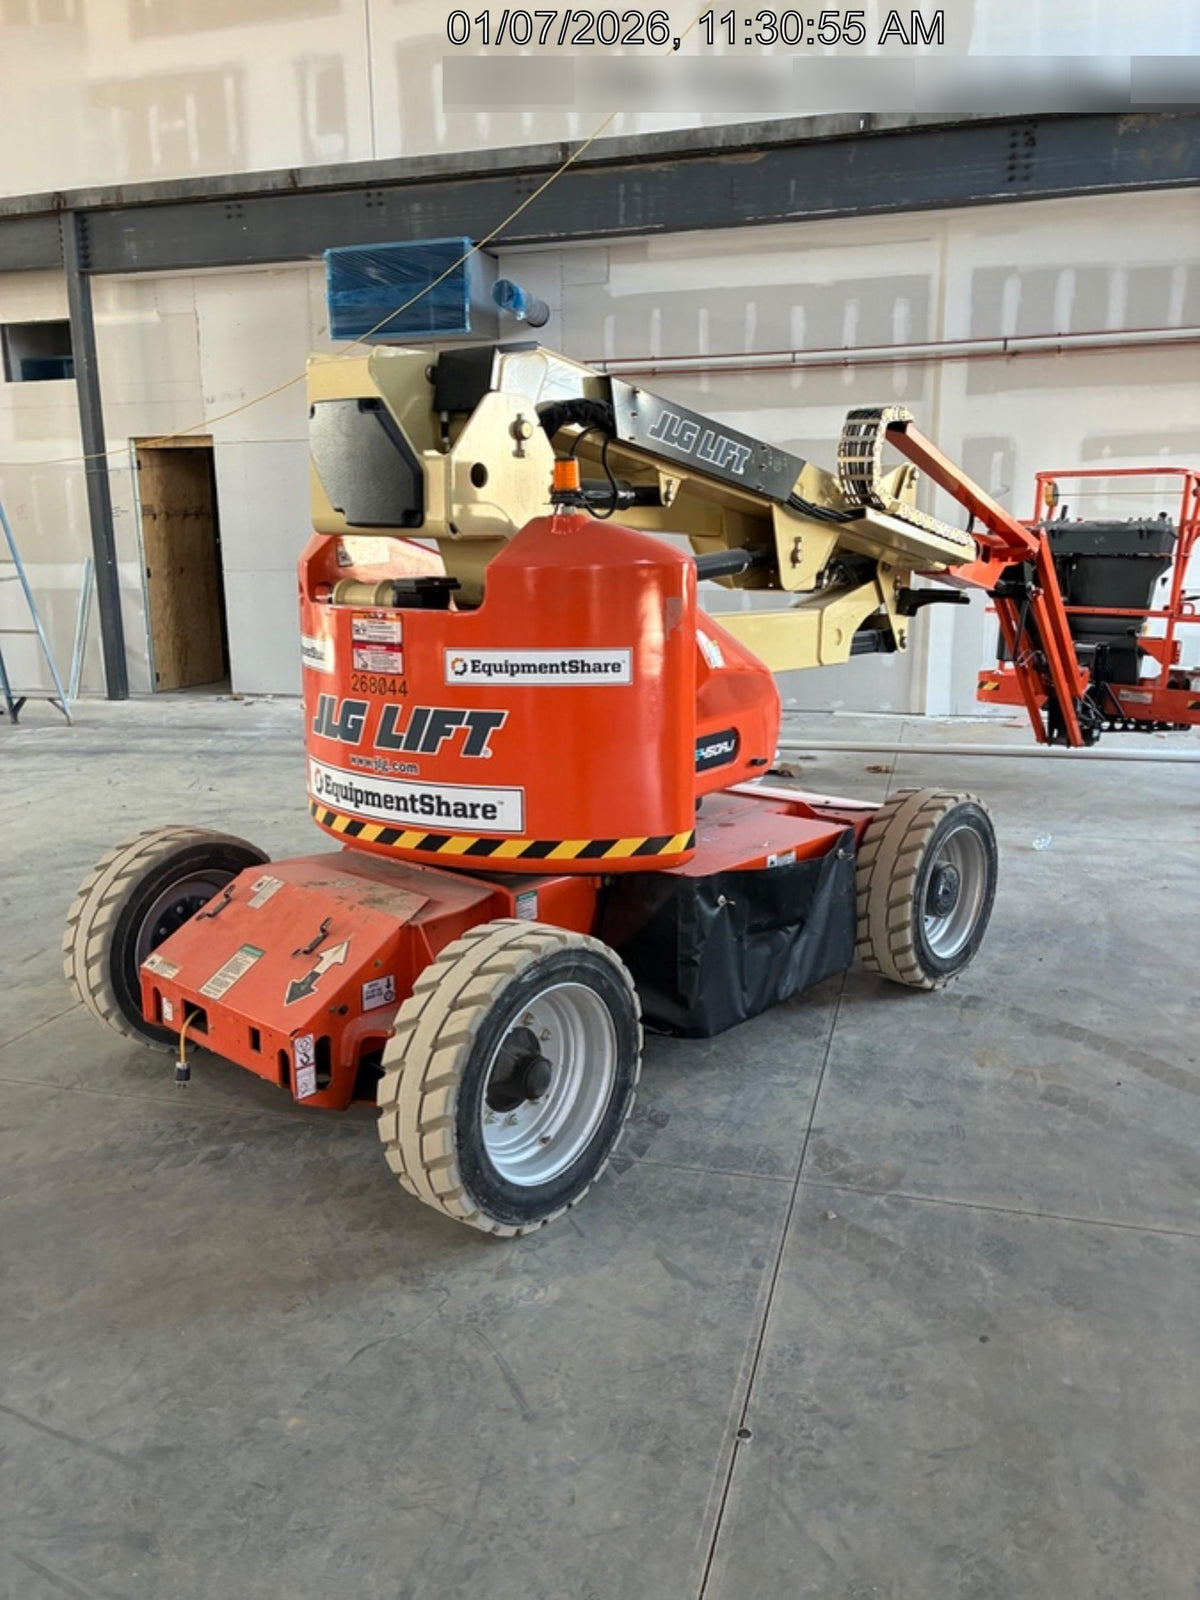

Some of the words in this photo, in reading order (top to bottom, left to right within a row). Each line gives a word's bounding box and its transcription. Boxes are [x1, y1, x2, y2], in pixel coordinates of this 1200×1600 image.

[646, 410, 700, 454] JLG
[696, 429, 752, 475] LIFT
[351, 673, 408, 697] 268044
[470, 659, 622, 677] EquipmentShare
[312, 693, 370, 746] JLG
[373, 703, 509, 757] LIFT
[350, 754, 419, 775] www.jlg.com
[323, 774, 498, 821] EquipmentShare
